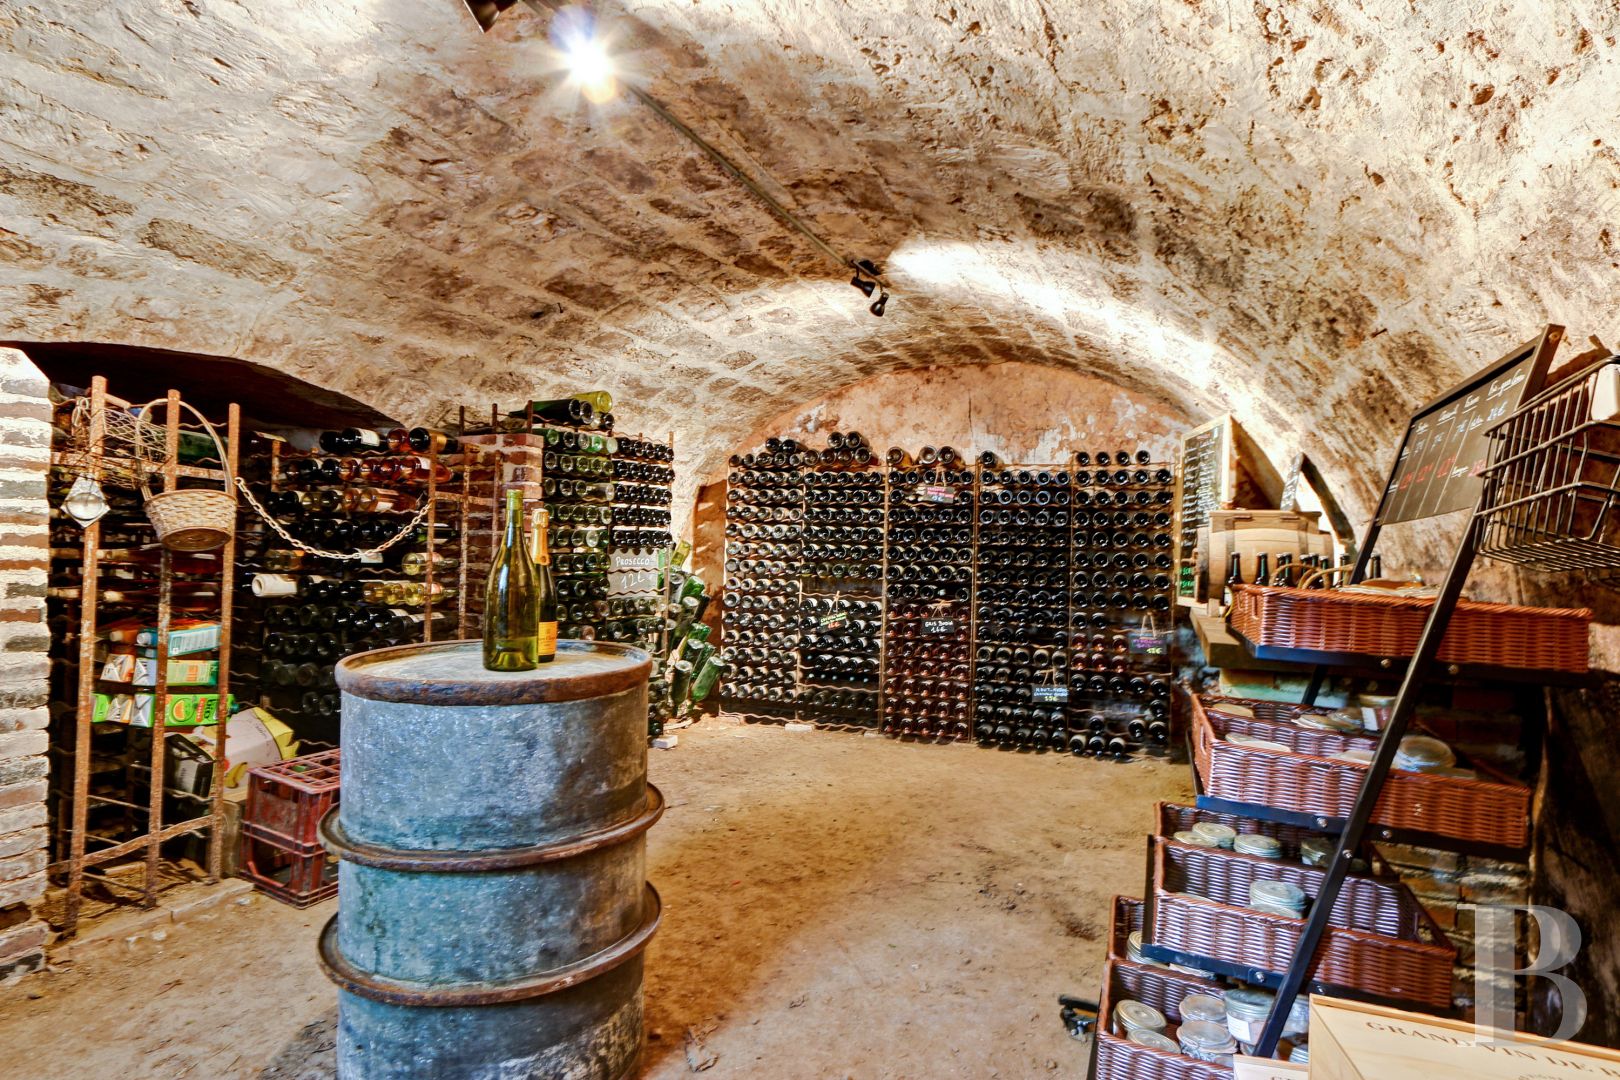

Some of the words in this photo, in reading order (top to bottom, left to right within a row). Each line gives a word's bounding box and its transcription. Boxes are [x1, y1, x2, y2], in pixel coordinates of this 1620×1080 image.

[615, 556, 650, 567] PROSECCO
[1365, 1021, 1472, 1047] GRAND
[1479, 1042, 1537, 1061] VIN
[1546, 1055, 1595, 1073] DE
